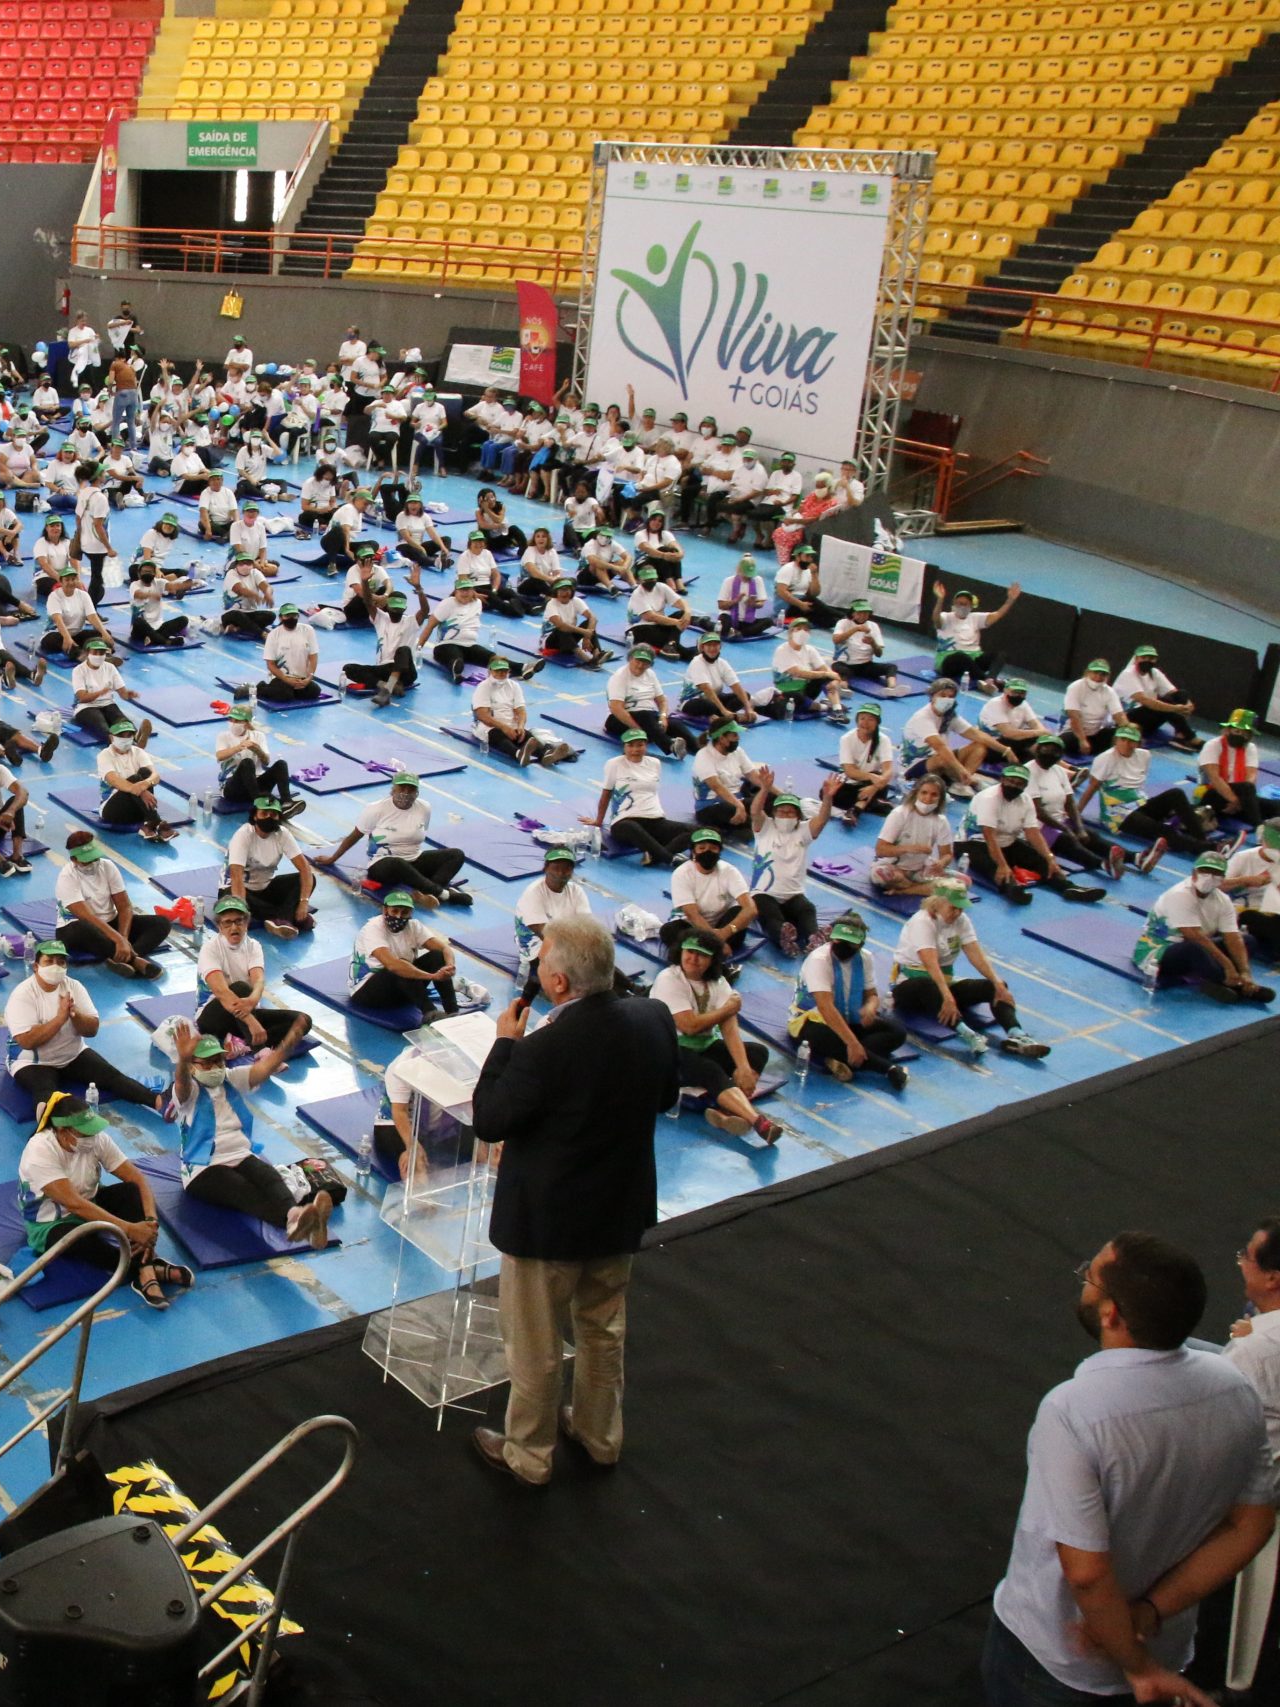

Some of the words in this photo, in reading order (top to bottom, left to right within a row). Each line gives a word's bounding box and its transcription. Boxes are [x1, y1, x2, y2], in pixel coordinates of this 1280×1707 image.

[199, 129, 231, 142] SAÍDA
[233, 132, 247, 142] DE
[188, 144, 256, 157] EMERGÊNCIA
[717, 262, 838, 384] Viva
